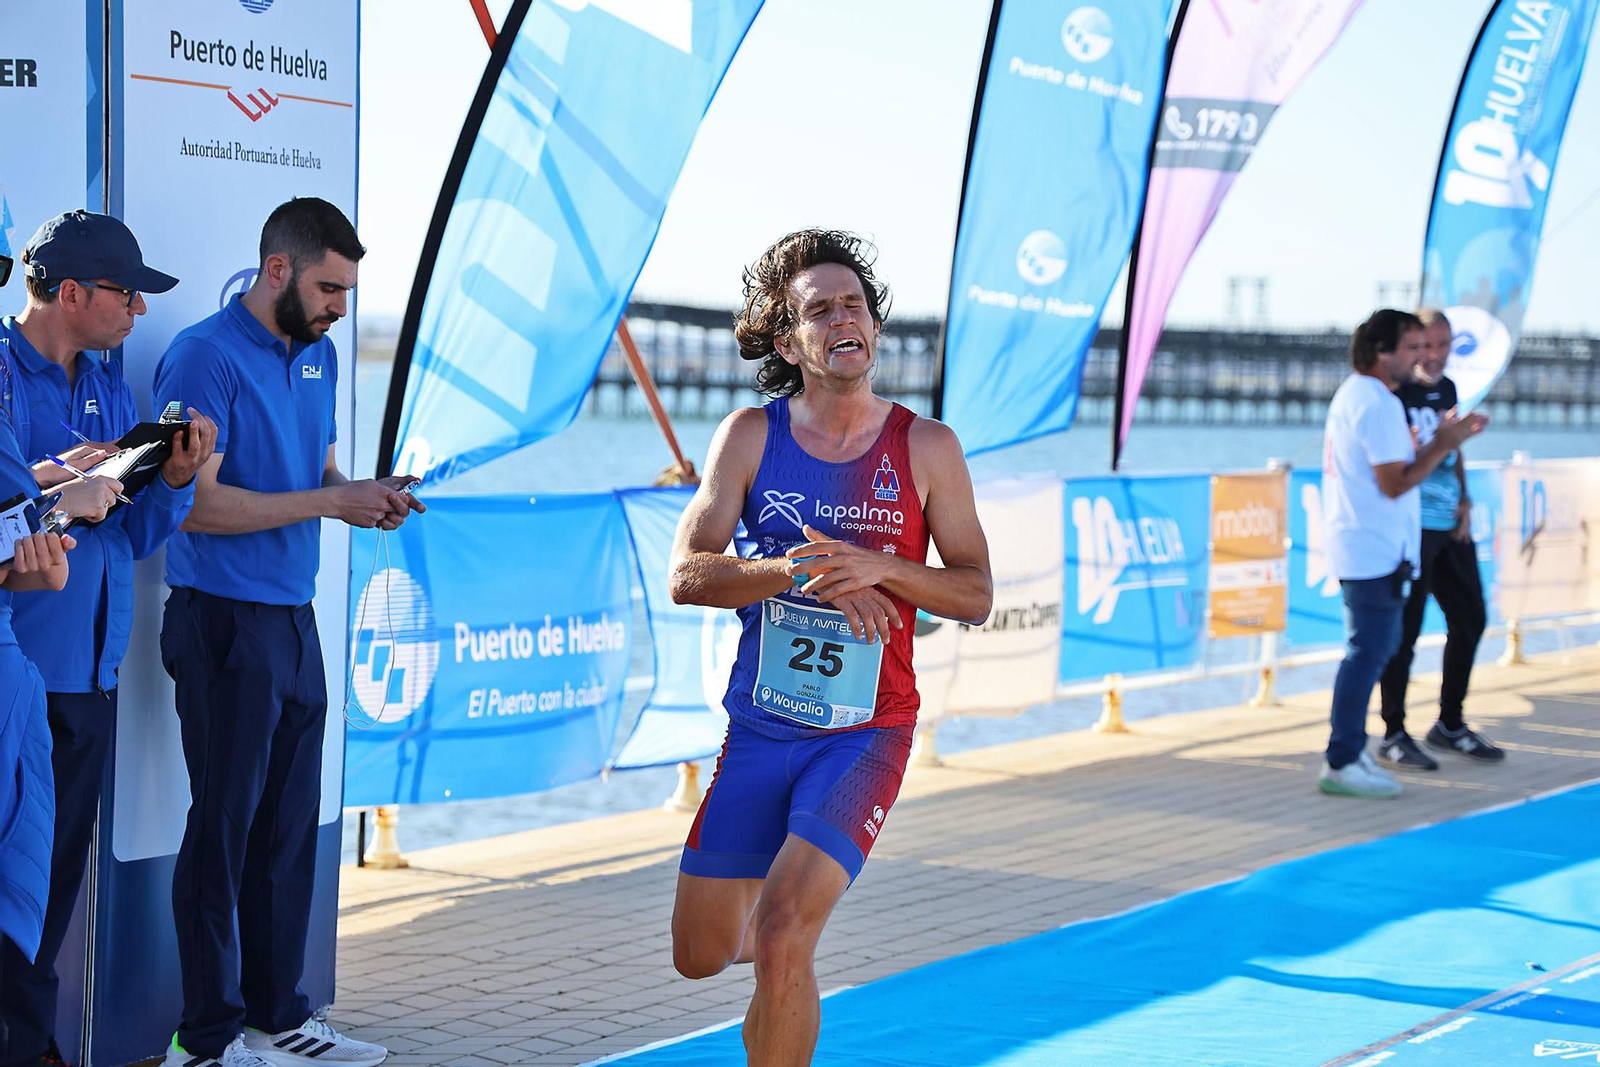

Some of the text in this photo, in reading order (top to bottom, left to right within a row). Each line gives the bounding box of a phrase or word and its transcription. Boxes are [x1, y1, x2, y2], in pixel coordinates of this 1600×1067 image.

[170, 30, 328, 81] Puerto de Huelva
[1064, 70, 1088, 91] de
[180, 137, 322, 170] Autoridad Portuaria de Huelva
[302, 365, 322, 374] CNJ
[814, 500, 904, 526] lapalma
[785, 610, 810, 626] HUELVA
[454, 611, 625, 664] Puerto de Huelva
[788, 636, 845, 679] 25
[802, 683, 821, 692] PABLO
[467, 688, 487, 719] El
[486, 688, 537, 718] Puerto
[538, 690, 563, 713] con
[772, 690, 825, 718] Wayalia
